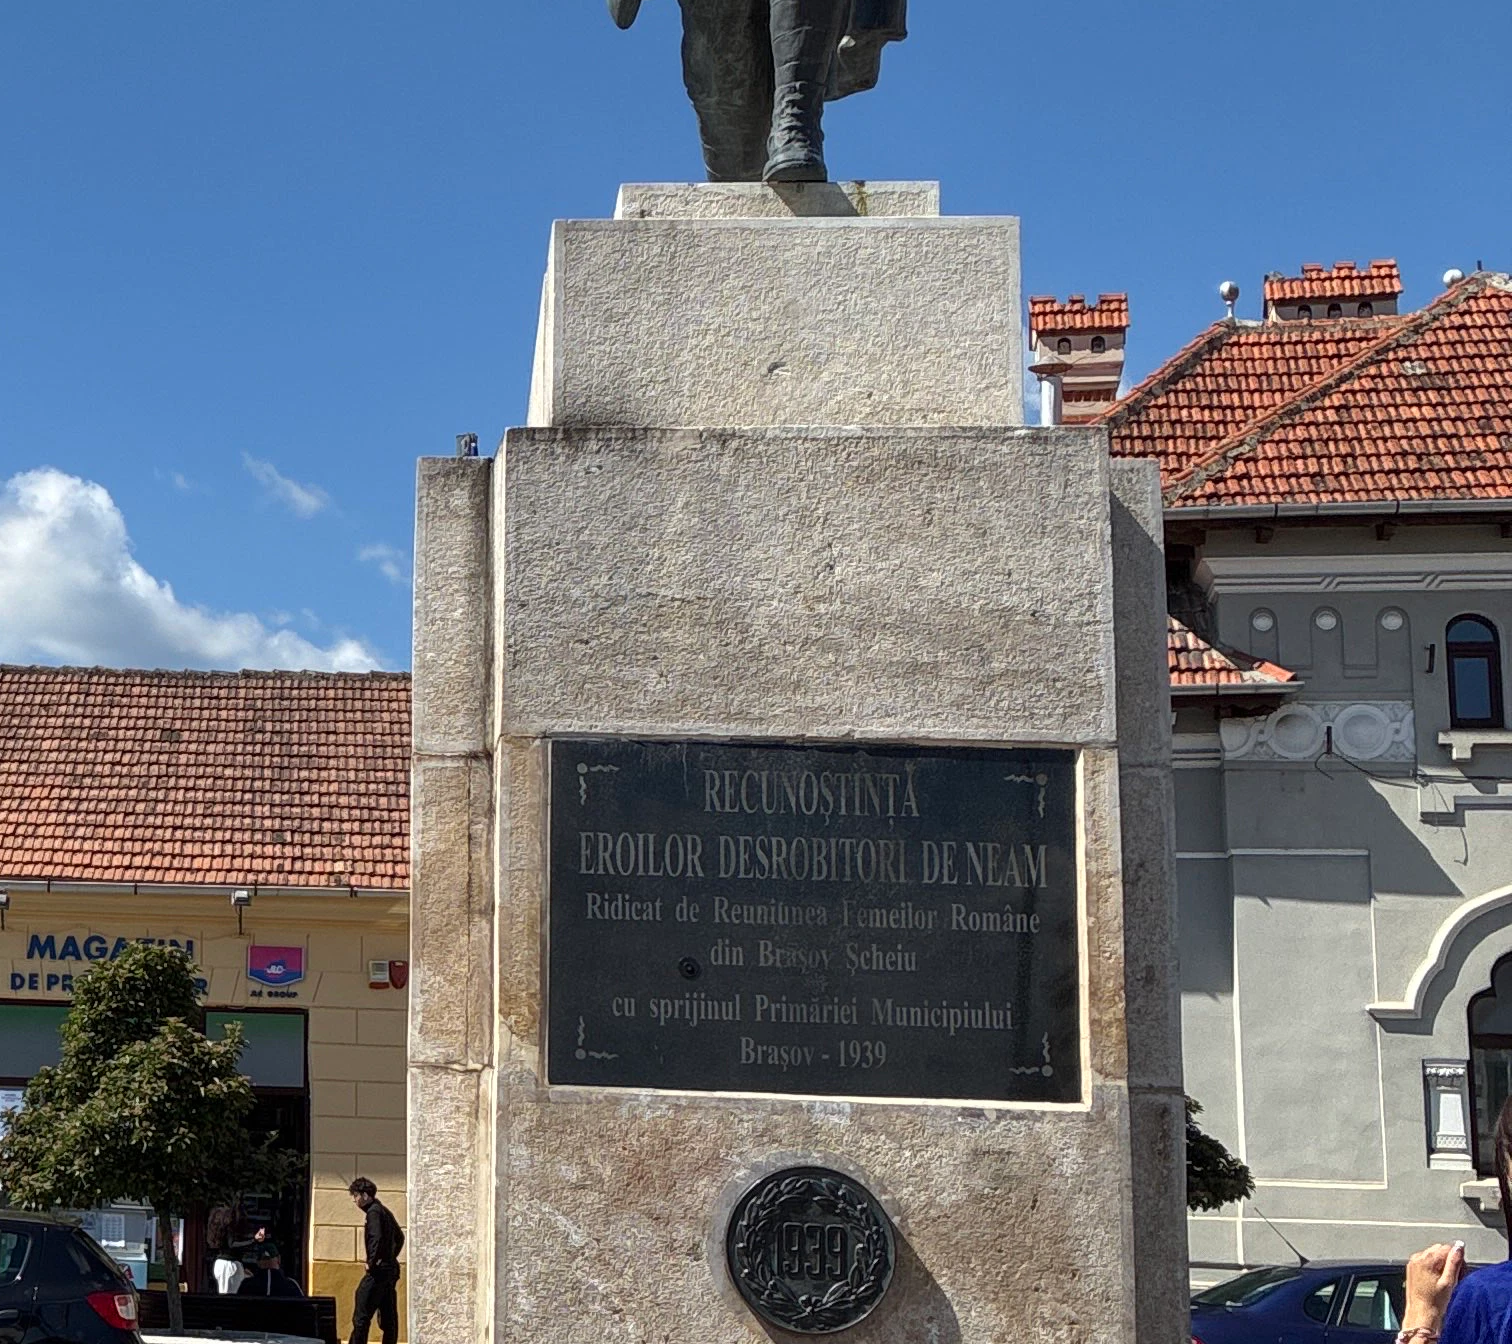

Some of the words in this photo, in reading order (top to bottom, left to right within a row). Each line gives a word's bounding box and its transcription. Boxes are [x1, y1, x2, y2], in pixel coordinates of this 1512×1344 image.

[579, 831, 705, 878] EROILOR
[718, 834, 907, 884] DESROBITORI
[921, 840, 959, 885] DE
[965, 842, 1048, 888] NEAM
[586, 892, 663, 922] Ridicat
[675, 896, 700, 923] de
[713, 896, 828, 926] Reuniunea
[842, 900, 937, 930] Femeilor
[951, 903, 1041, 934] Române
[710, 939, 745, 966] din
[10, 972, 38, 991] DE
[612, 996, 636, 1017] cu
[650, 993, 742, 1027] sprijinul
[755, 995, 858, 1025] Primăriei
[872, 999, 1014, 1036] Municipiului
[838, 1040, 887, 1068] 1939
[775, 1222, 848, 1281] 1939
